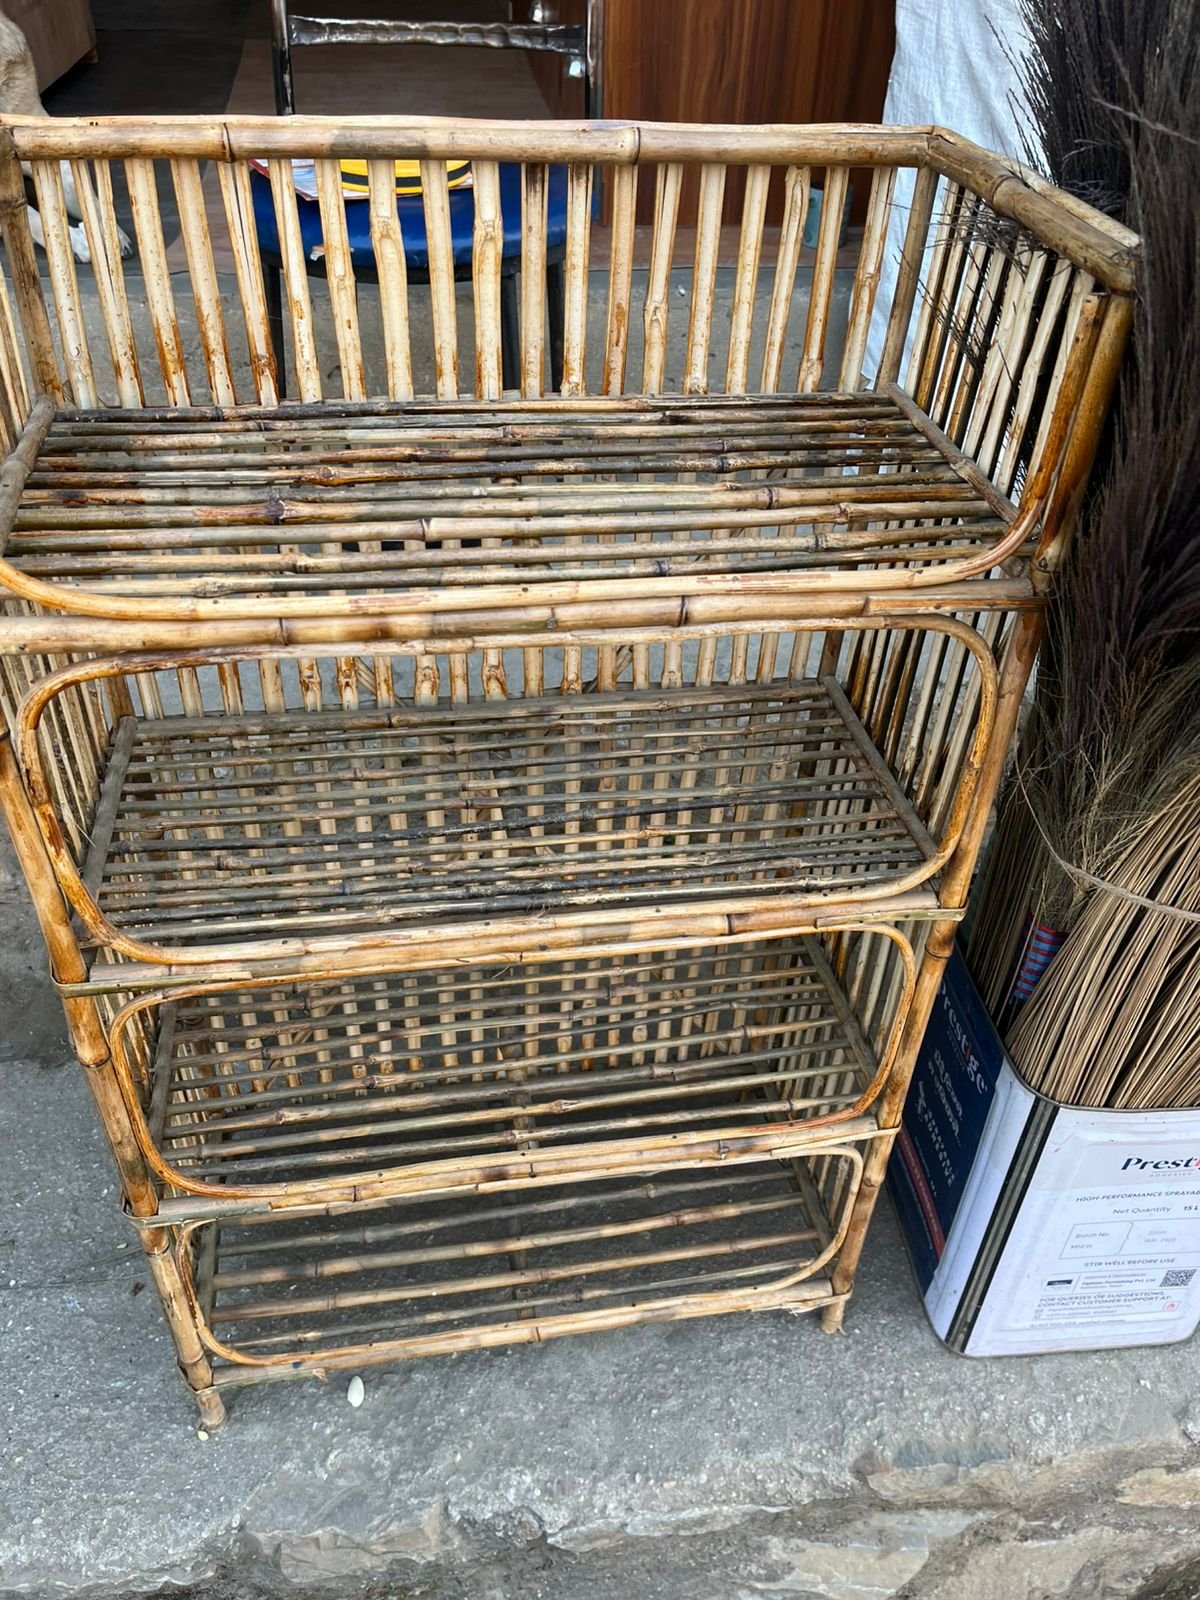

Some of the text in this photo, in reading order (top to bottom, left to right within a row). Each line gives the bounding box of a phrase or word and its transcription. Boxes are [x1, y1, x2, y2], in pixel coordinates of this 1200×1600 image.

[1075, 1191, 1162, 1202] HIGH-PERFORMANCE
[1131, 1206, 1172, 1215] Quantity
[1127, 1258, 1160, 1266] BEFORE
[1077, 1298, 1122, 1306] CUSTOMER
